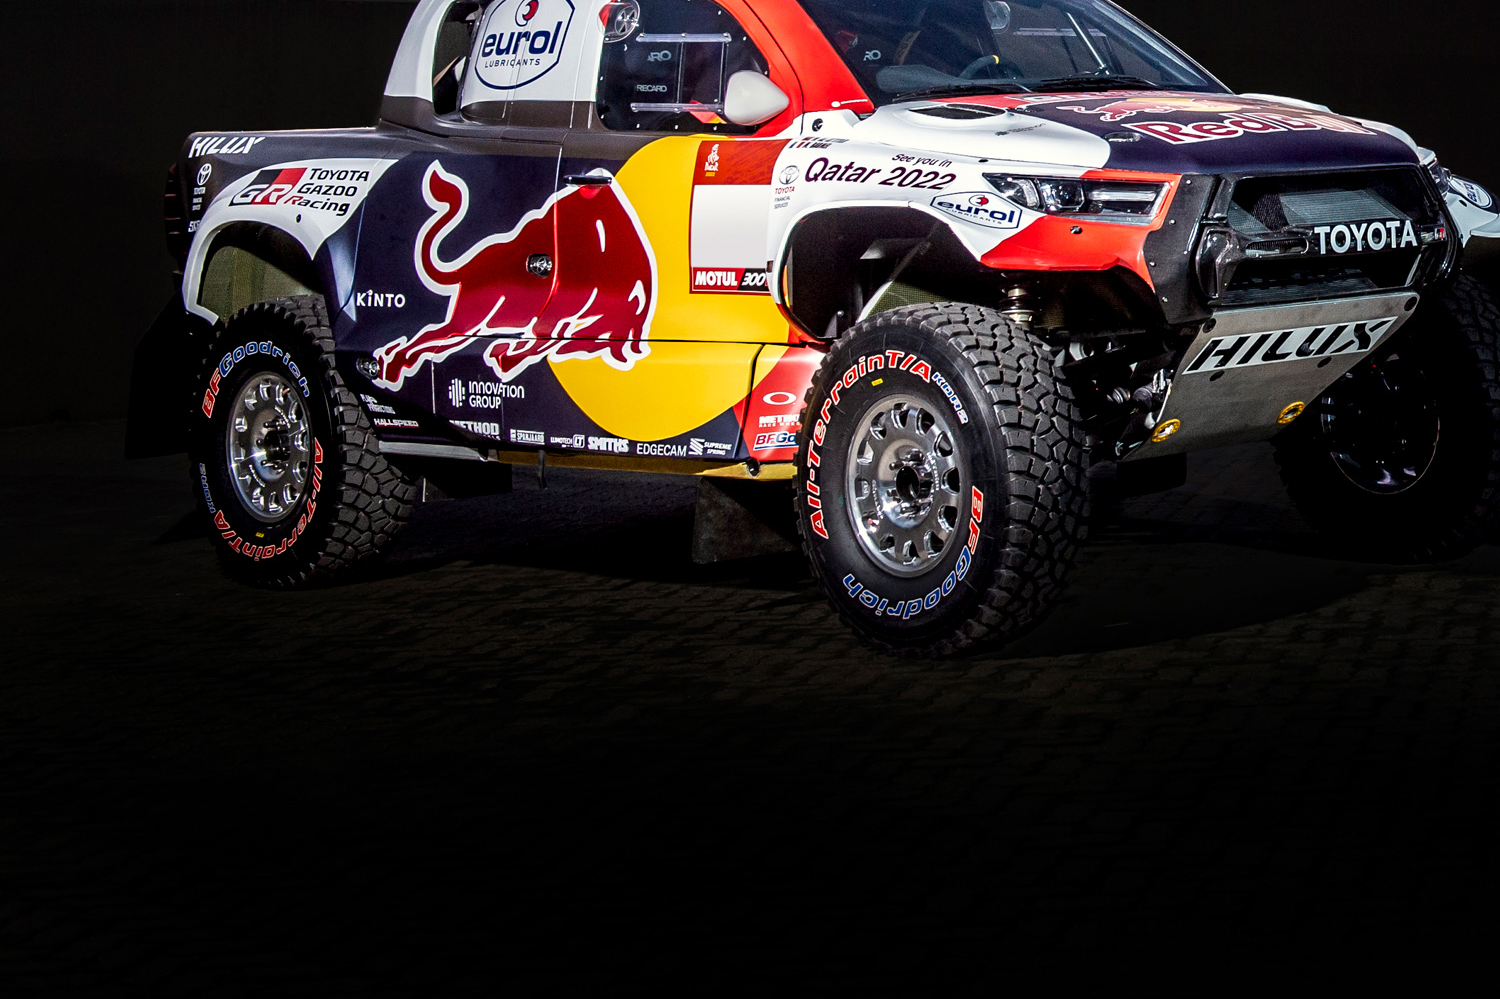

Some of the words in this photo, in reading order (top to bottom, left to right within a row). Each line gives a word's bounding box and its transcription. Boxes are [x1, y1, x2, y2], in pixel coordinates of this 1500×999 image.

[481, 21, 563, 57] eurol
[484, 58, 541, 69] LUBRICANTS
[636, 84, 669, 93] RECARO
[892, 153, 915, 164] See
[914, 156, 939, 166] you
[938, 159, 953, 168] in
[310, 168, 370, 182] TOYOTA
[804, 157, 882, 185] Qatar
[879, 166, 957, 190] 2022
[297, 183, 358, 196] GAZOO
[775, 186, 796, 195] TOYOTA
[284, 196, 350, 216] Racing
[937, 202, 1015, 223] eurol
[1314, 219, 1418, 254] TOYOTA
[695, 271, 738, 286] MOTUL
[741, 273, 768, 286] 300
[1186, 319, 1393, 372] HILUX
[202, 341, 309, 418] BFGoodrich
[469, 381, 525, 399] INNOVATION
[469, 395, 501, 409] GROUP
[373, 418, 419, 427] HALLSPEED
[759, 414, 800, 424] METHO
[587, 436, 630, 454] SMITHS
[637, 442, 688, 457] EDGECAM
[703, 441, 733, 451] SUPREME
[843, 485, 984, 620] BFGoodrich
